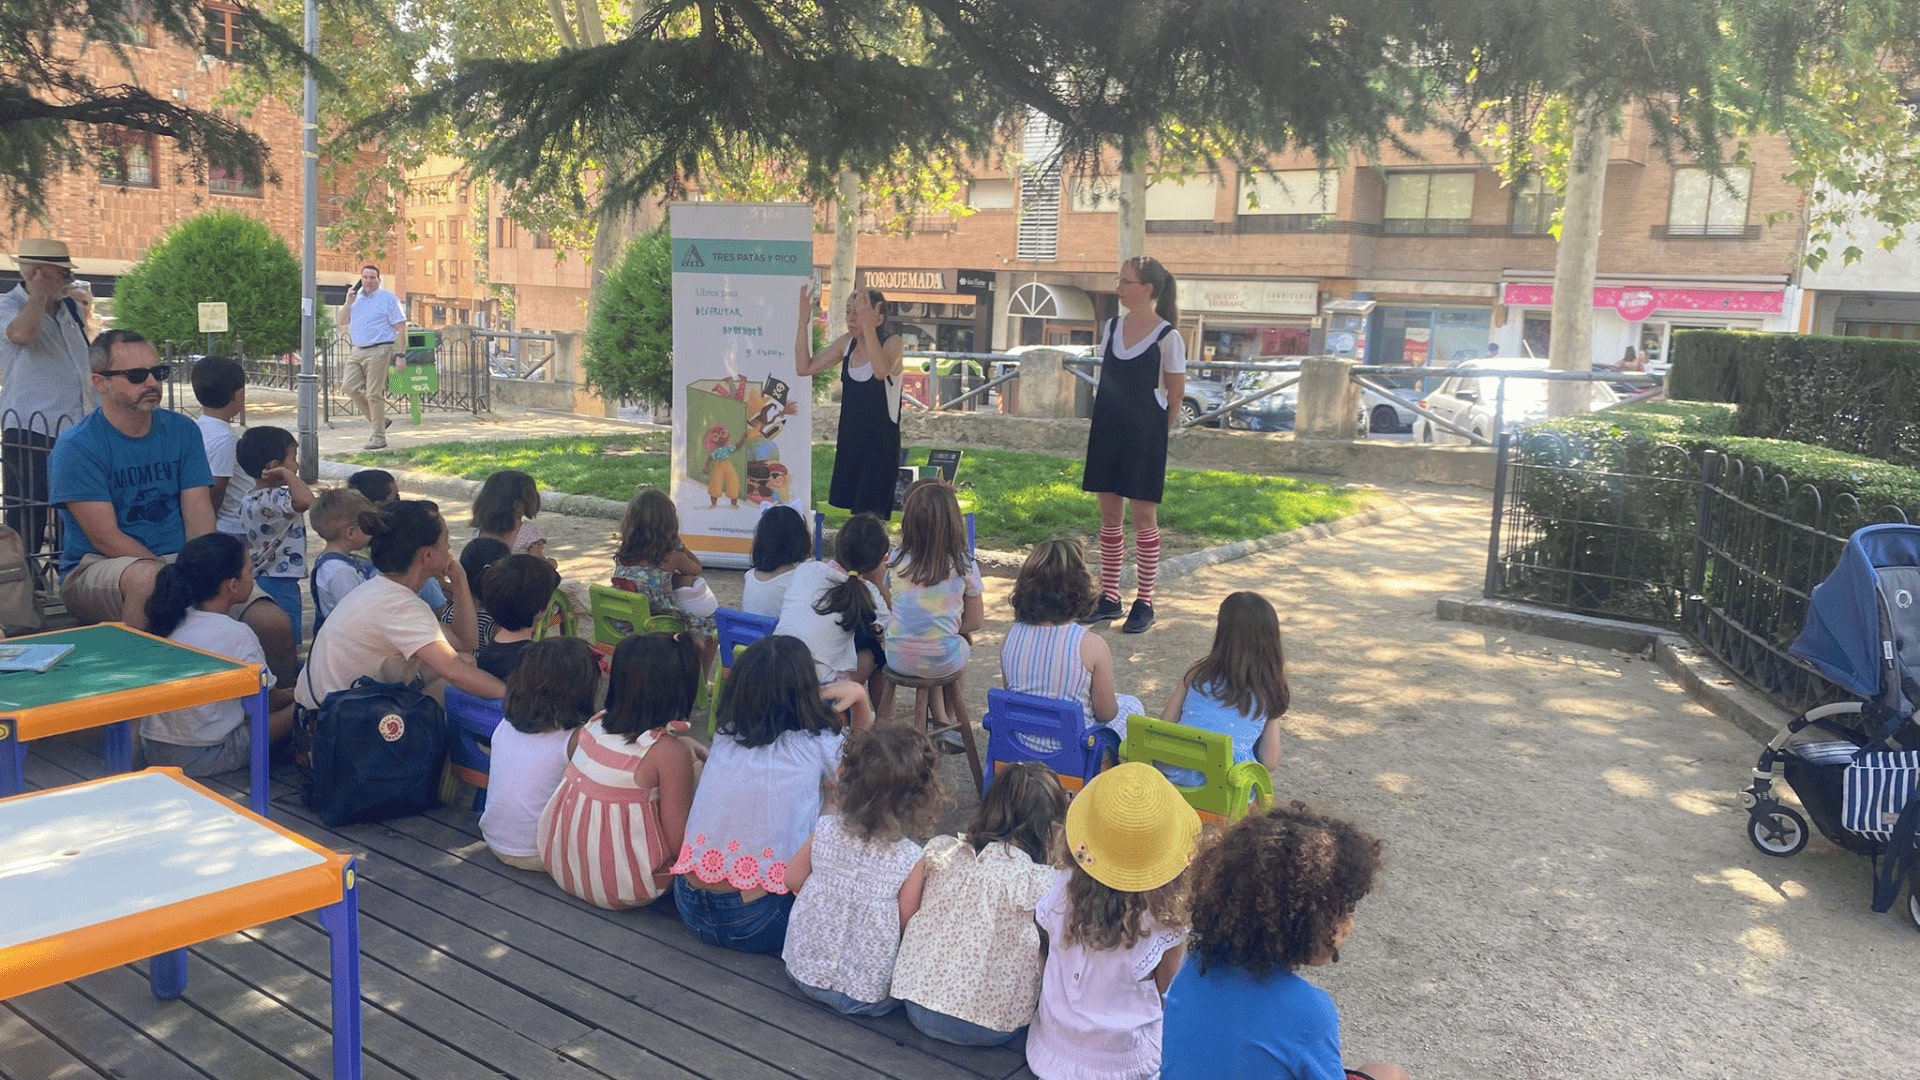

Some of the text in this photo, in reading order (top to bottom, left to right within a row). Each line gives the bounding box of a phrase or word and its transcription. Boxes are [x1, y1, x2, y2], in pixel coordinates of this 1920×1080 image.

[712, 252, 797, 264] TRES PATAS Y PICO
[864, 271, 946, 290] TORQUEMADA
[696, 288, 738, 298] Libros para
[695, 306, 743, 318] DISFRUTAR,
